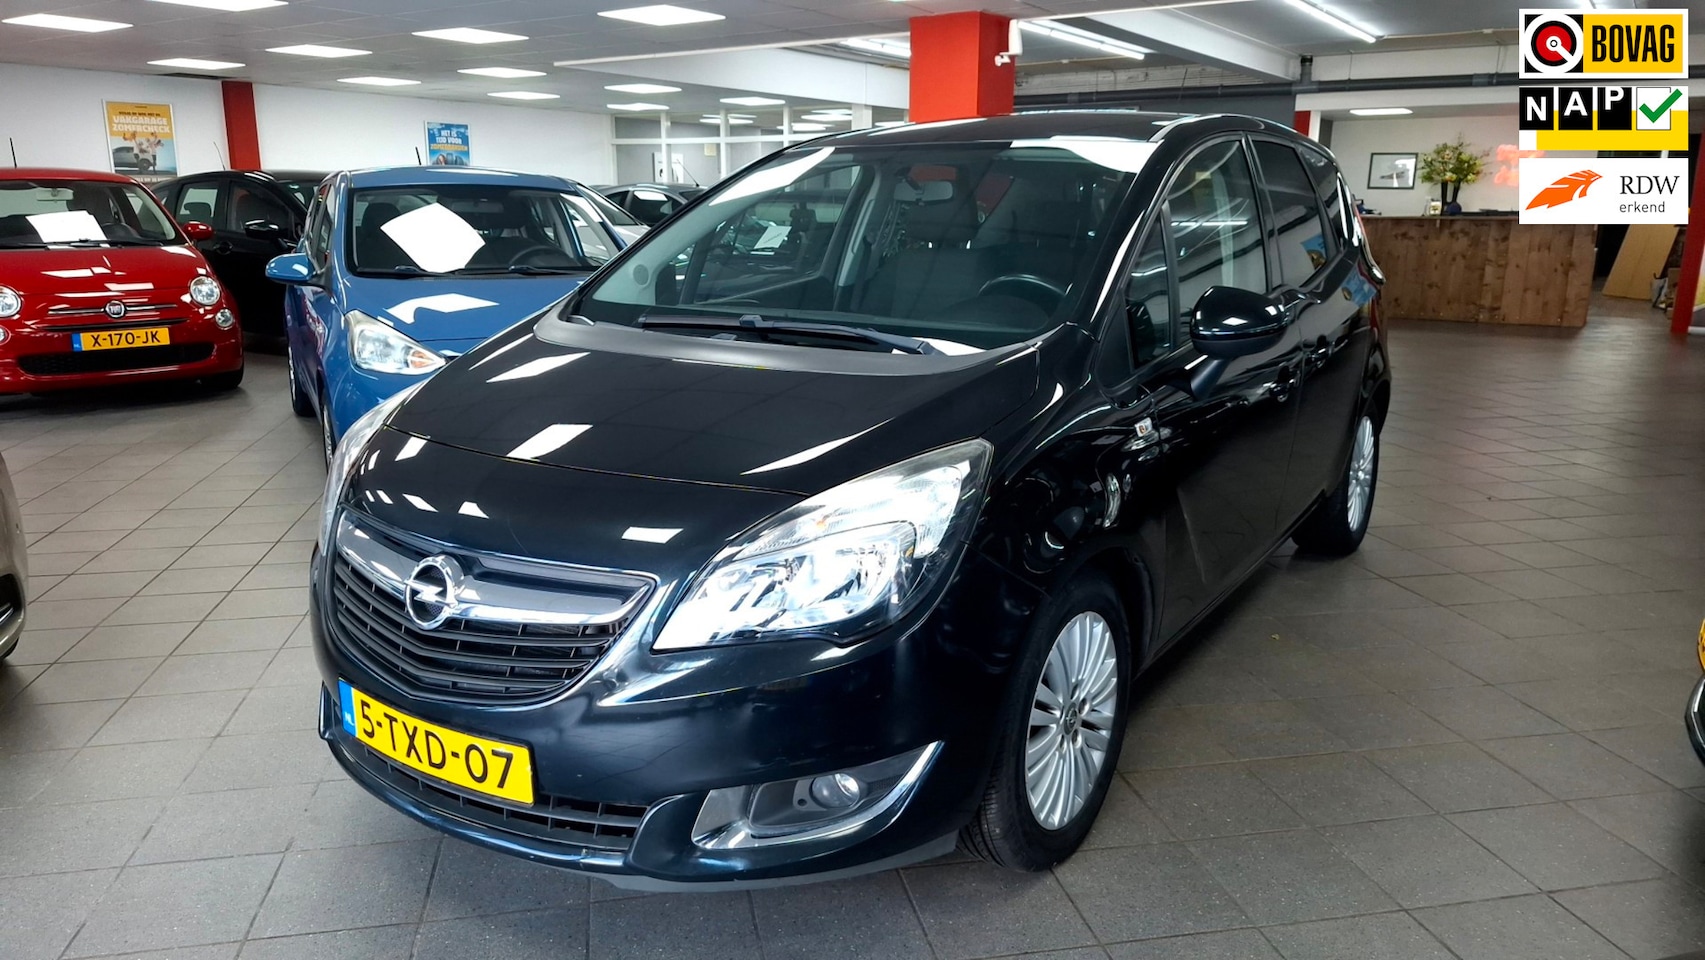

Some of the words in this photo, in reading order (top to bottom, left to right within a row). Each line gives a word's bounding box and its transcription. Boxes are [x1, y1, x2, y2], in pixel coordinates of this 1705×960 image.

[112, 115, 168, 126] VAKGARAGE
[112, 123, 170, 133] ZOMERCHECK
[90, 330, 161, 348] X-170-JK
[344, 713, 355, 726] NL
[360, 699, 514, 789] 5-TXD-07
